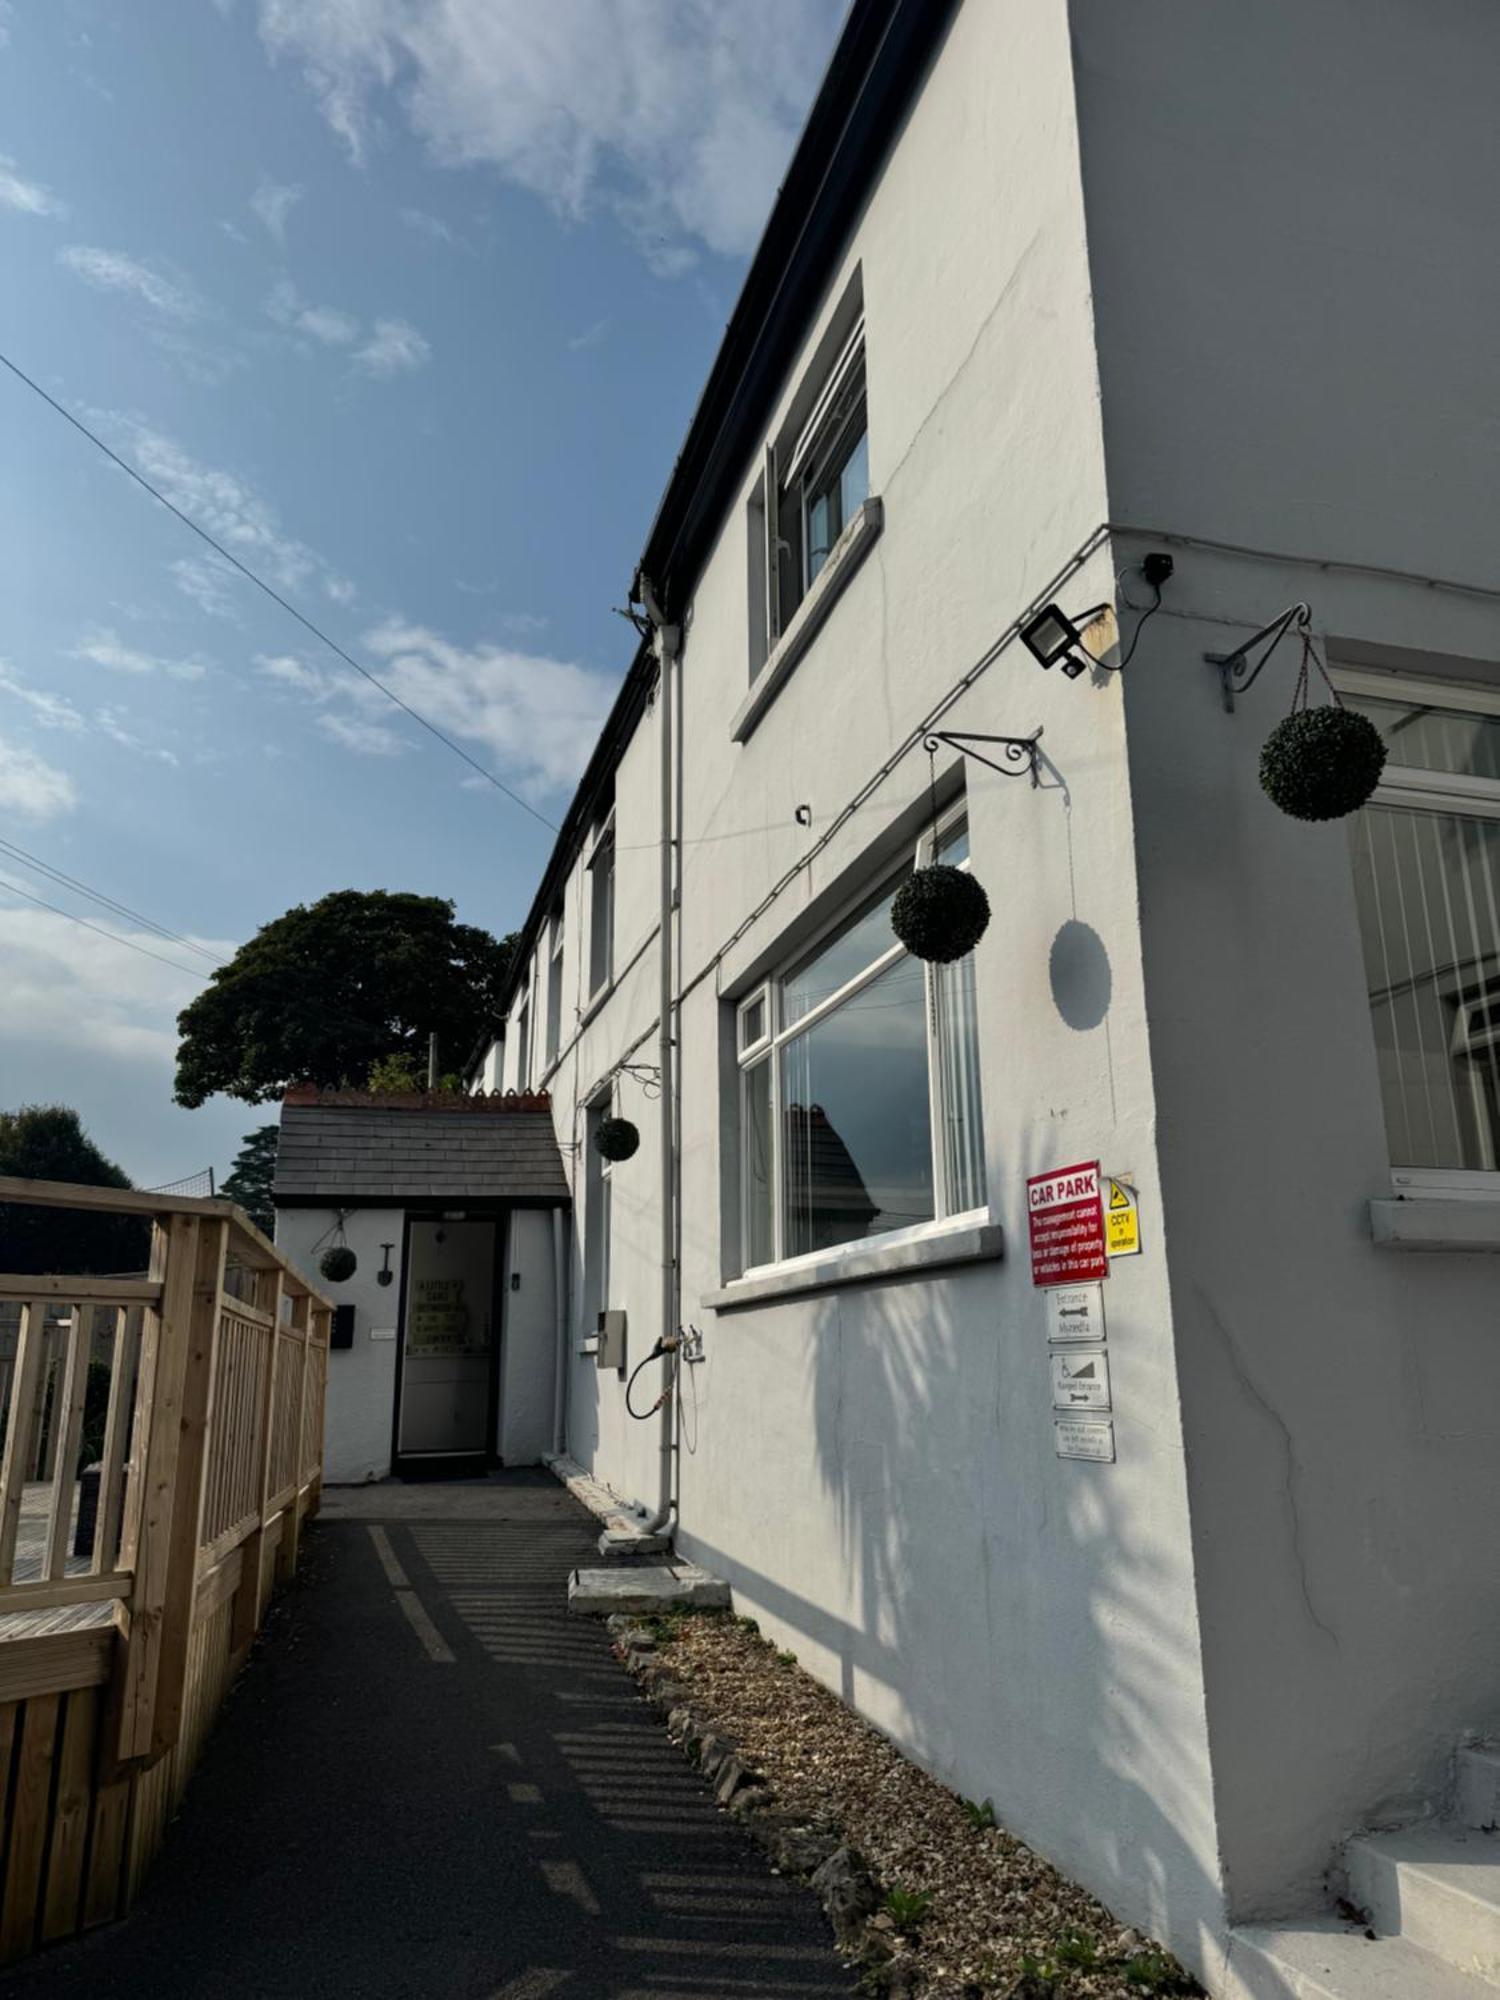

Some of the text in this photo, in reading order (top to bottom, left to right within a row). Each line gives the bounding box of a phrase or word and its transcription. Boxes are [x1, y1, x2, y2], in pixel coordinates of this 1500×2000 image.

[1031, 1174, 1095, 1206] CAR PARK
[1076, 1206, 1097, 1218] cannot
[1111, 1213, 1130, 1226] CCTV
[1051, 1223, 1088, 1240] responsibility
[1088, 1221, 1097, 1232] for
[1049, 1243, 1070, 1257] damage
[1078, 1239, 1103, 1254] property
[1111, 1237, 1135, 1248] operation
[1040, 1262, 1061, 1273] vehicles
[1068, 1259, 1079, 1270] this
[1079, 1258, 1089, 1267] car
[1090, 1255, 1104, 1269] park
